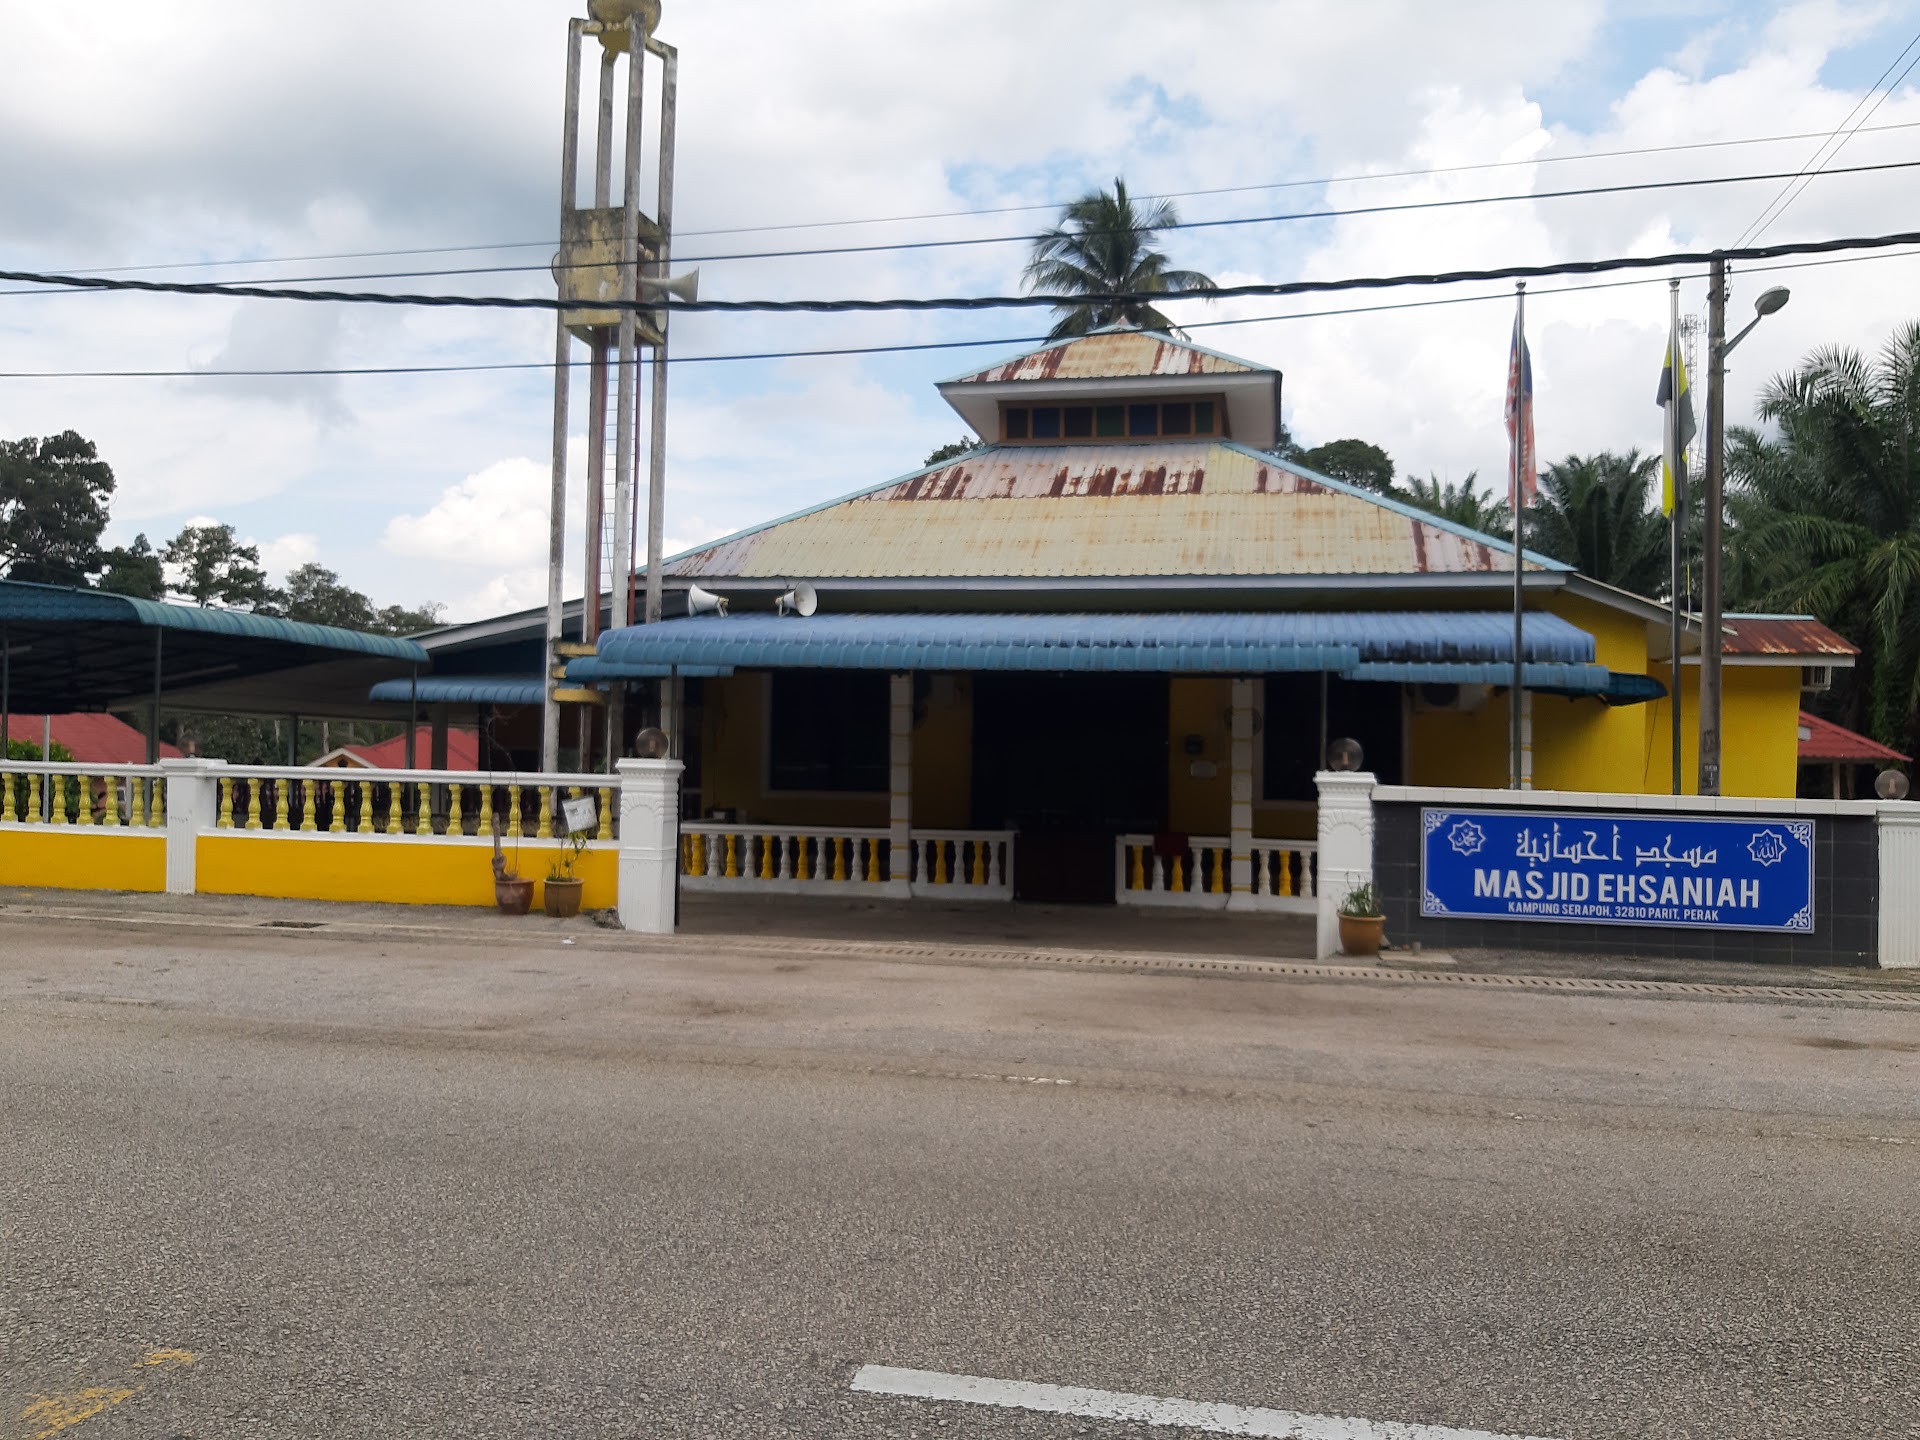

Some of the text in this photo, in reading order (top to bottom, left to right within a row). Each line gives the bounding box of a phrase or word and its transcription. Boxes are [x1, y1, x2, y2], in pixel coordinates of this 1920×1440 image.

[1635, 834, 1718, 868] مسجد
[1474, 868, 1760, 909] MASJID EHSANIAH
[1508, 901, 1560, 915] KAMPUNG
[1562, 904, 1612, 918] SERAPOH,
[1614, 905, 1646, 919] 32810
[1683, 910, 1719, 922] PERAK
